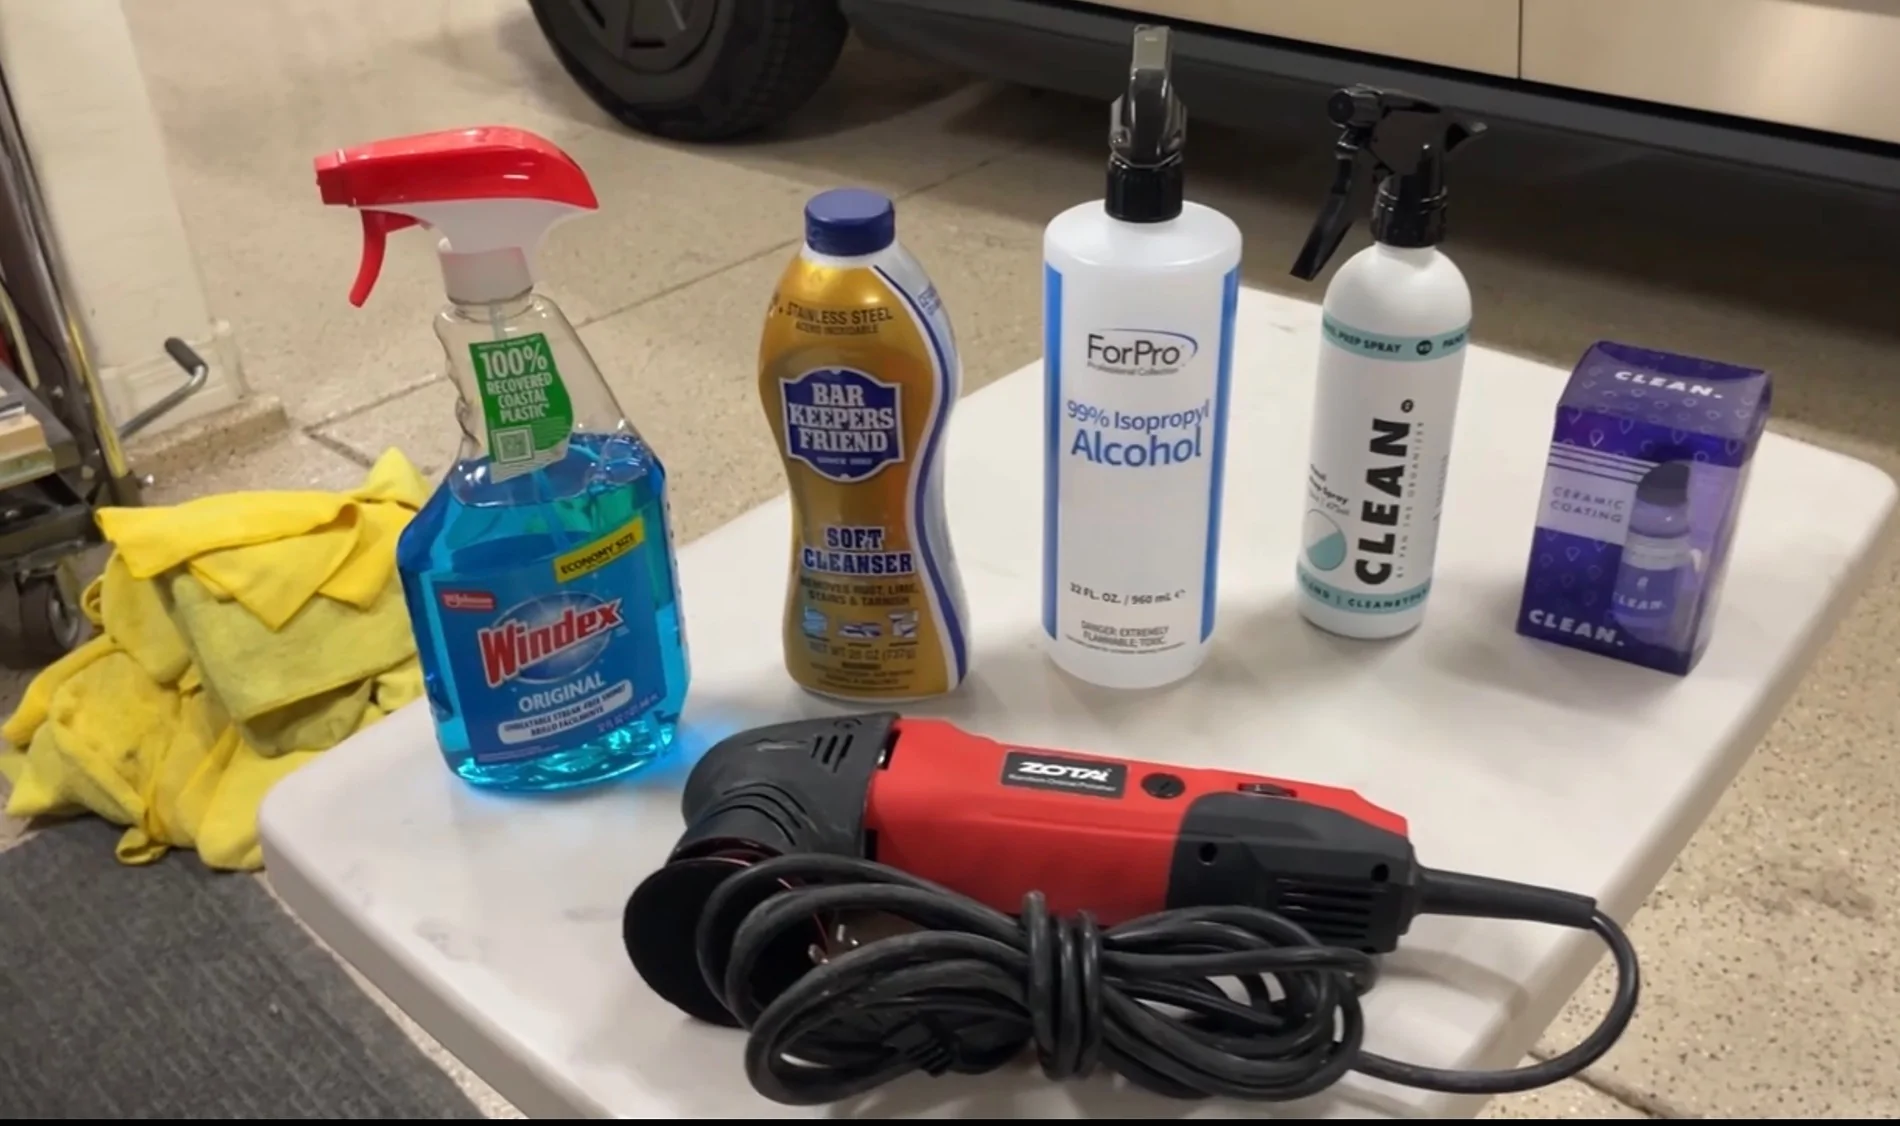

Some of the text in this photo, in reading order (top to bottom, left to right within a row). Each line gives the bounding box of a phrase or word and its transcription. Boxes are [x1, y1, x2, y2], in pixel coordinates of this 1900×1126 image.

[852, 307, 894, 325] STEEL
[1087, 333, 1181, 366] ForPro
[1363, 339, 1402, 353] SPRAY
[480, 342, 548, 380] 100%
[486, 372, 553, 395] RECOVERED
[811, 383, 865, 407] BAR
[498, 389, 549, 409] COASTAL
[788, 402, 895, 430] KEEPERS
[1067, 398, 1210, 435] 99% Isopropyl
[797, 427, 889, 453] FRIEND
[1071, 425, 1202, 468] Alcohol
[1552, 485, 1625, 511] CERAMIC
[1550, 499, 1623, 524] COATING
[826, 527, 883, 549] SOFT
[560, 543, 614, 574] ECONOMY
[803, 548, 913, 574] CLEANSER
[1102, 592, 1122, 604] OZ.
[1528, 609, 1625, 647] CLEAN.
[477, 598, 623, 688] Windex
[518, 674, 606, 712] ORIGINAL
